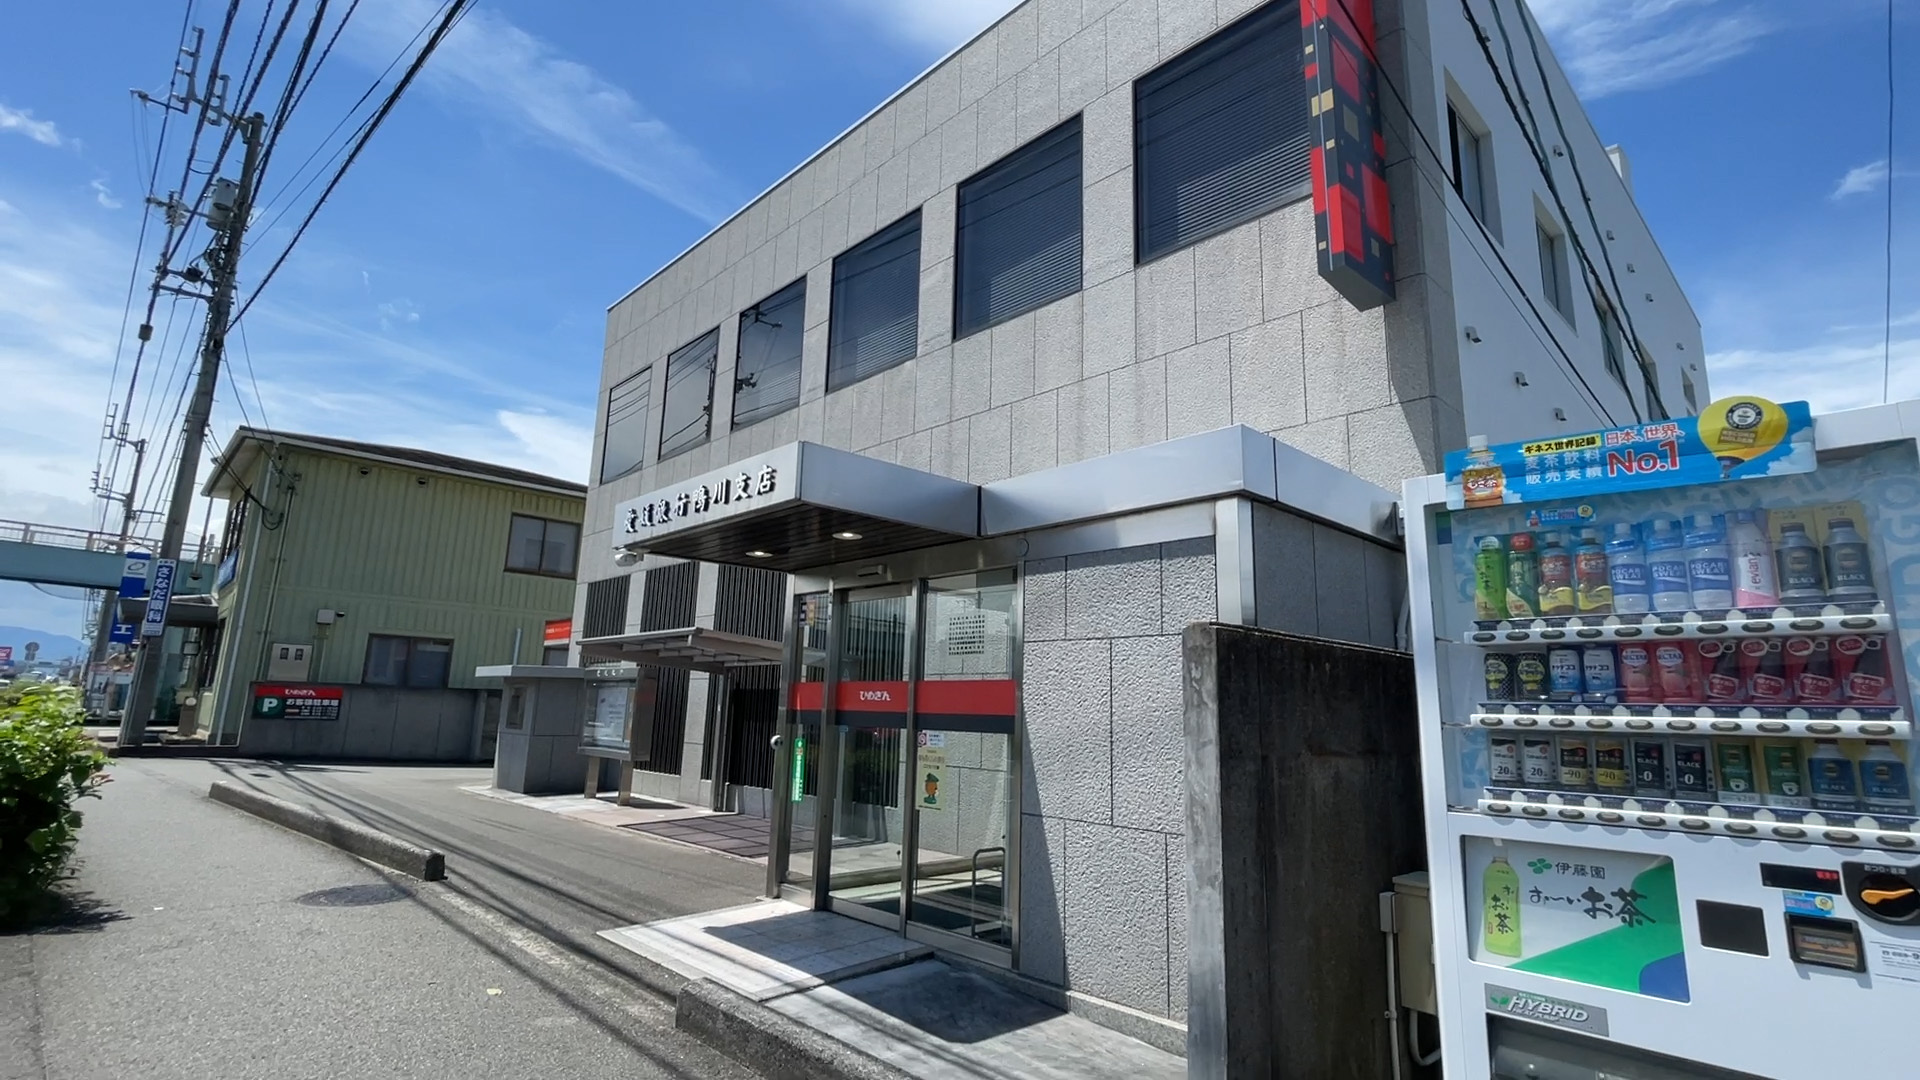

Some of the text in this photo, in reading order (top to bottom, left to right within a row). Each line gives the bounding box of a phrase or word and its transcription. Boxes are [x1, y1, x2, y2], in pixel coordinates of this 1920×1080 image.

[1607, 439, 1680, 477] No.1
[1751, 556, 1761, 586] evian
[262, 698, 278, 712] P
[1555, 861, 1606, 880] 伊藤園
[1508, 996, 1590, 1022] HYBRID
